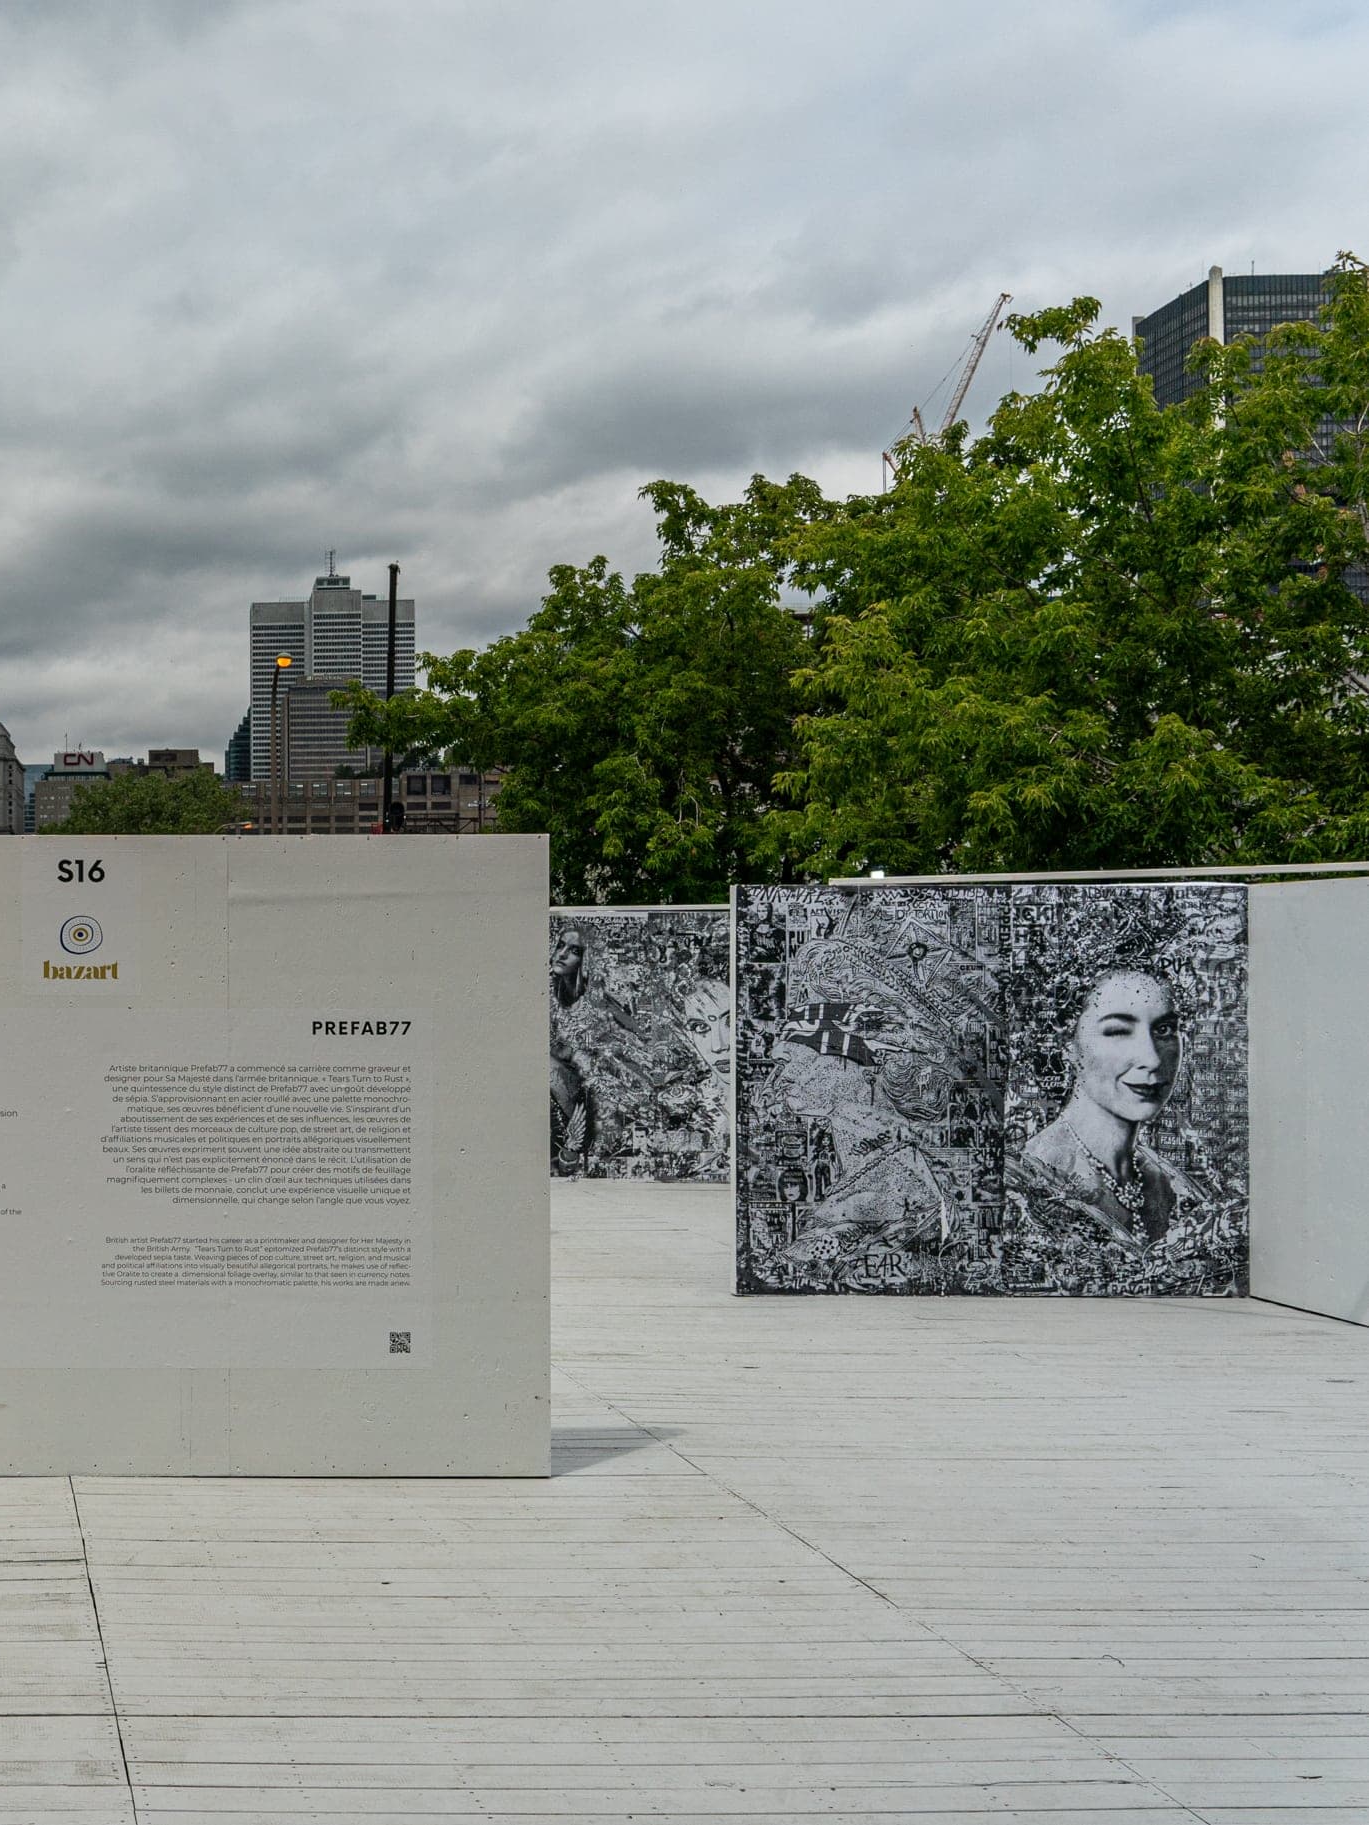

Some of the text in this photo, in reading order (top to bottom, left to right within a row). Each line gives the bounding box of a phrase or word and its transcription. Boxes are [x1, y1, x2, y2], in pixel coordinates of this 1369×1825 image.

[64, 753, 95, 766] CN
[57, 859, 106, 883] S16
[43, 960, 120, 980] bazart
[312, 1021, 412, 1036] PREFAB77
[138, 1065, 189, 1074] britannique
[368, 1066, 401, 1074] graveur
[130, 1085, 188, 1094] quintessence
[202, 1085, 222, 1094] style
[344, 1085, 365, 1094] goût
[366, 1085, 411, 1094] développé
[346, 1105, 390, 1114] S'inspirant
[101, 1135, 152, 1143] d'affiliations
[153, 1135, 196, 1143] musicales
[208, 1135, 251, 1144] politiques
[265, 1135, 301, 1144] portraits
[302, 1135, 355, 1144] allégoriques
[356, 1135, 411, 1143] visuellement
[241, 1196, 256, 1205] qui
[257, 1196, 290, 1205] change
[291, 1196, 314, 1204] selon
[316, 1196, 344, 1205] l'angle
